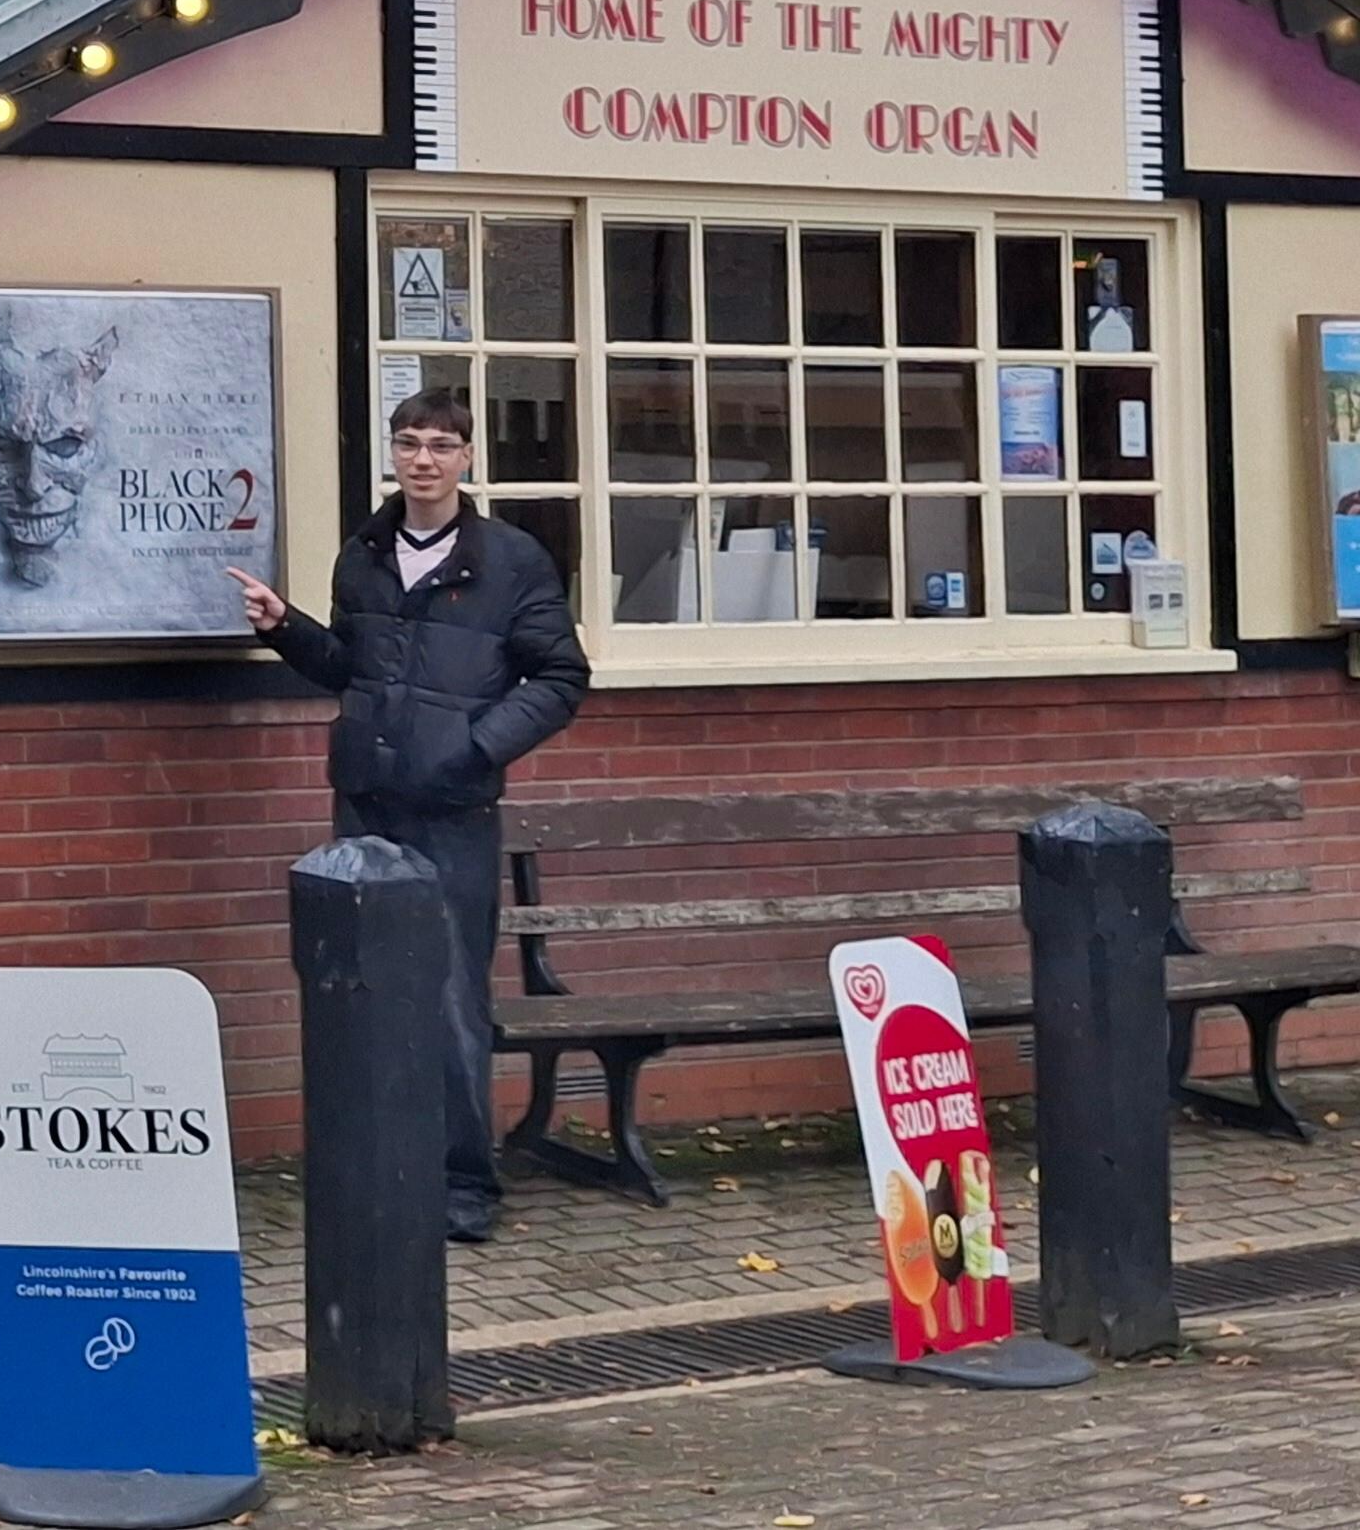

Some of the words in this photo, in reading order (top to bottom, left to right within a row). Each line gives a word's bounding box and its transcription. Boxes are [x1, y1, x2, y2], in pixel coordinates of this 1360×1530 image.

[775, 1, 862, 54] THE
[884, 10, 1070, 66] MIGHTY
[562, 86, 832, 149] COMPTON
[865, 99, 1039, 159] ORGAN
[119, 468, 224, 499] BLACK
[225, 467, 259, 531] 2
[119, 501, 226, 532] PHONE
[883, 1057, 912, 1095] ICE
[911, 1048, 971, 1092] CREAM
[891, 1099, 937, 1141] SOLD
[936, 1091, 979, 1132] HERE
[47, 1157, 74, 1170] TEA
[88, 1157, 144, 1171] COFFEE
[15, 1283, 63, 1298] Coffee
[65, 1285, 120, 1299] Roaster
[122, 1286, 162, 1300] Since
[163, 1288, 198, 1302] 1902
[22, 1264, 117, 1280] Lincolnshire's
[119, 1267, 187, 1282] Favourite
